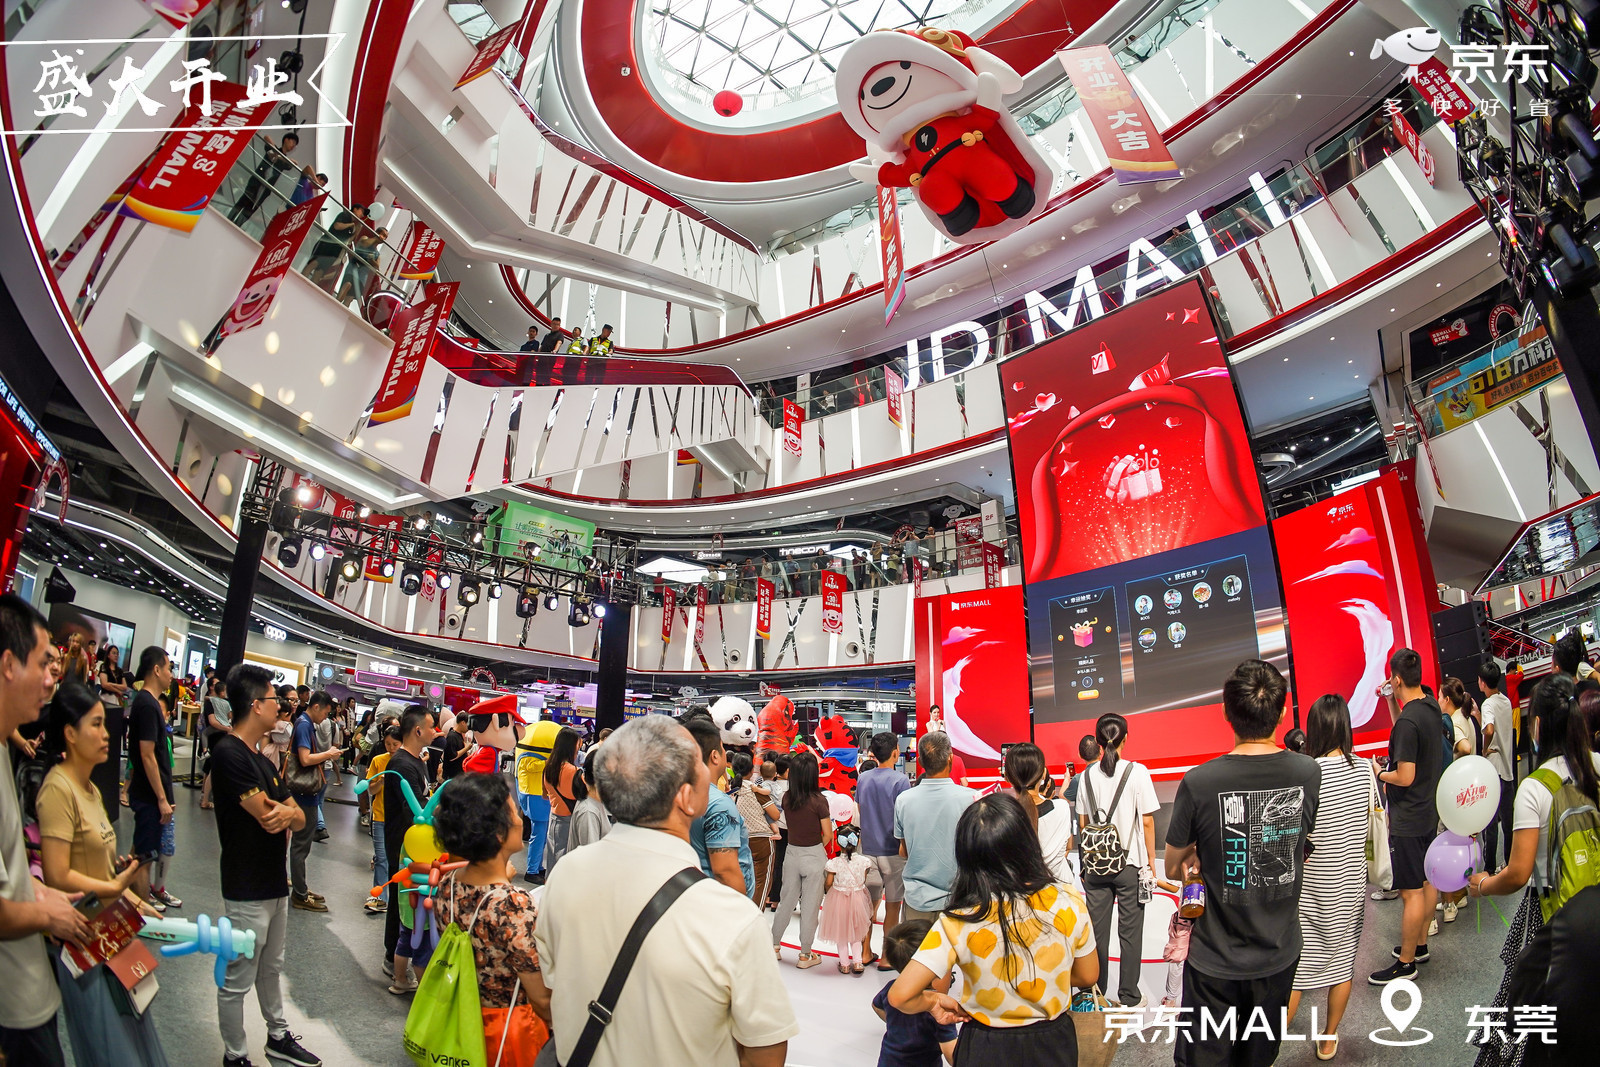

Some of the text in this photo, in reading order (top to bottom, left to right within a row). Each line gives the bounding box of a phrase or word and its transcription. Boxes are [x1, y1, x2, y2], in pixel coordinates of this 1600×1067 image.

[382, 317, 420, 402] 京东MALL
[903, 320, 990, 393] JD
[266, 625, 287, 642] oppo
[1225, 837, 1247, 890] FAST
[431, 1052, 470, 1067] vanke
